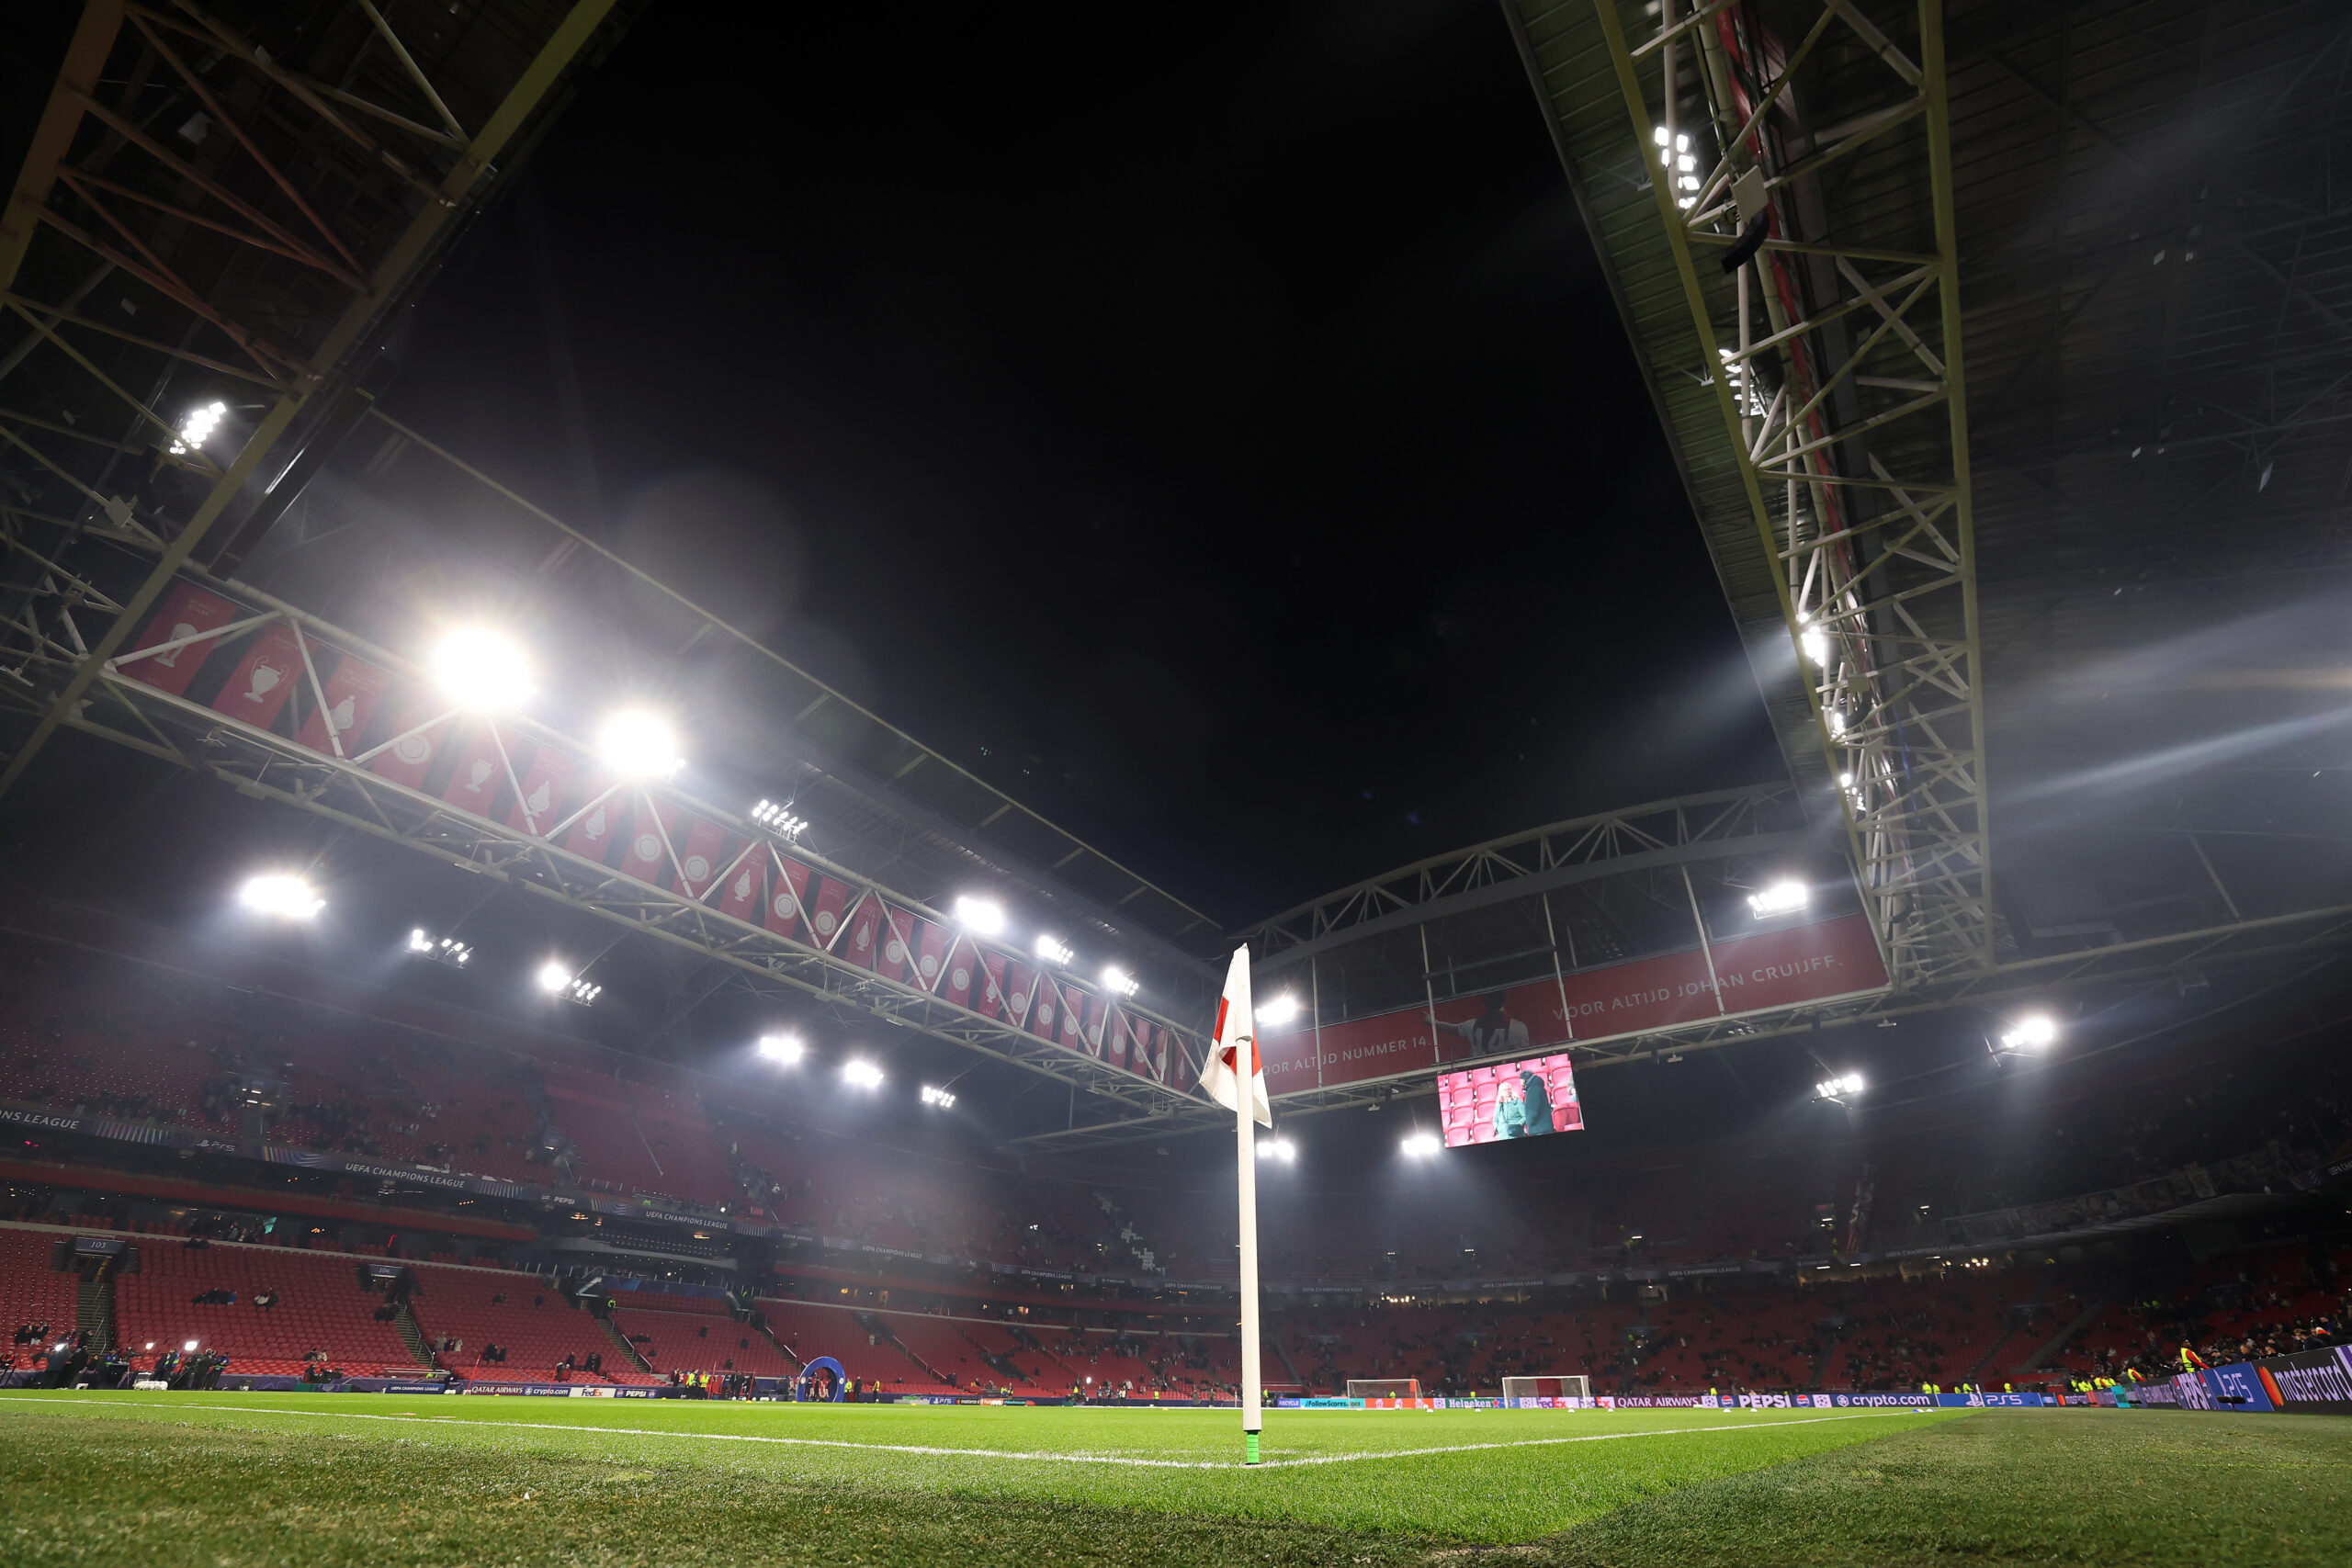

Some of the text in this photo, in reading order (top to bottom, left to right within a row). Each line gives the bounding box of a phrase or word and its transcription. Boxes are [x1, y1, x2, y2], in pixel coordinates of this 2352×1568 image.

[1554, 1001, 1605, 1021] VOOR
[1612, 987, 1670, 1010] ALTIJD
[1678, 974, 1744, 997] JOHAN
[1261, 1061, 1290, 1077] OOR
[1295, 1054, 1338, 1071] ALTJD
[1342, 1040, 1408, 1061] NUMMER
[24, 1113, 80, 1130] LEAGUE
[345, 1162, 465, 1189] UEFA CHAMPIONS LEAGUE
[554, 1196, 575, 1205] PEPSI
[646, 1211, 729, 1230] UEFA CHAMPIONS LEAGUE
[91, 1241, 107, 1249] 103
[2274, 1355, 2352, 1402] mastercard
[471, 1385, 494, 1393] QATAR
[533, 1387, 568, 1396] crypto.com
[582, 1388, 603, 1397] FedEx
[626, 1389, 647, 1397] PEPSI
[1449, 1399, 1492, 1408] Heineken
[1617, 1396, 1698, 1407] QATAR AIRWAYS
[1738, 1394, 1789, 1407] PEPSI
[1851, 1393, 1930, 1407] crypto.com
[1984, 1394, 2022, 1404] PS5
